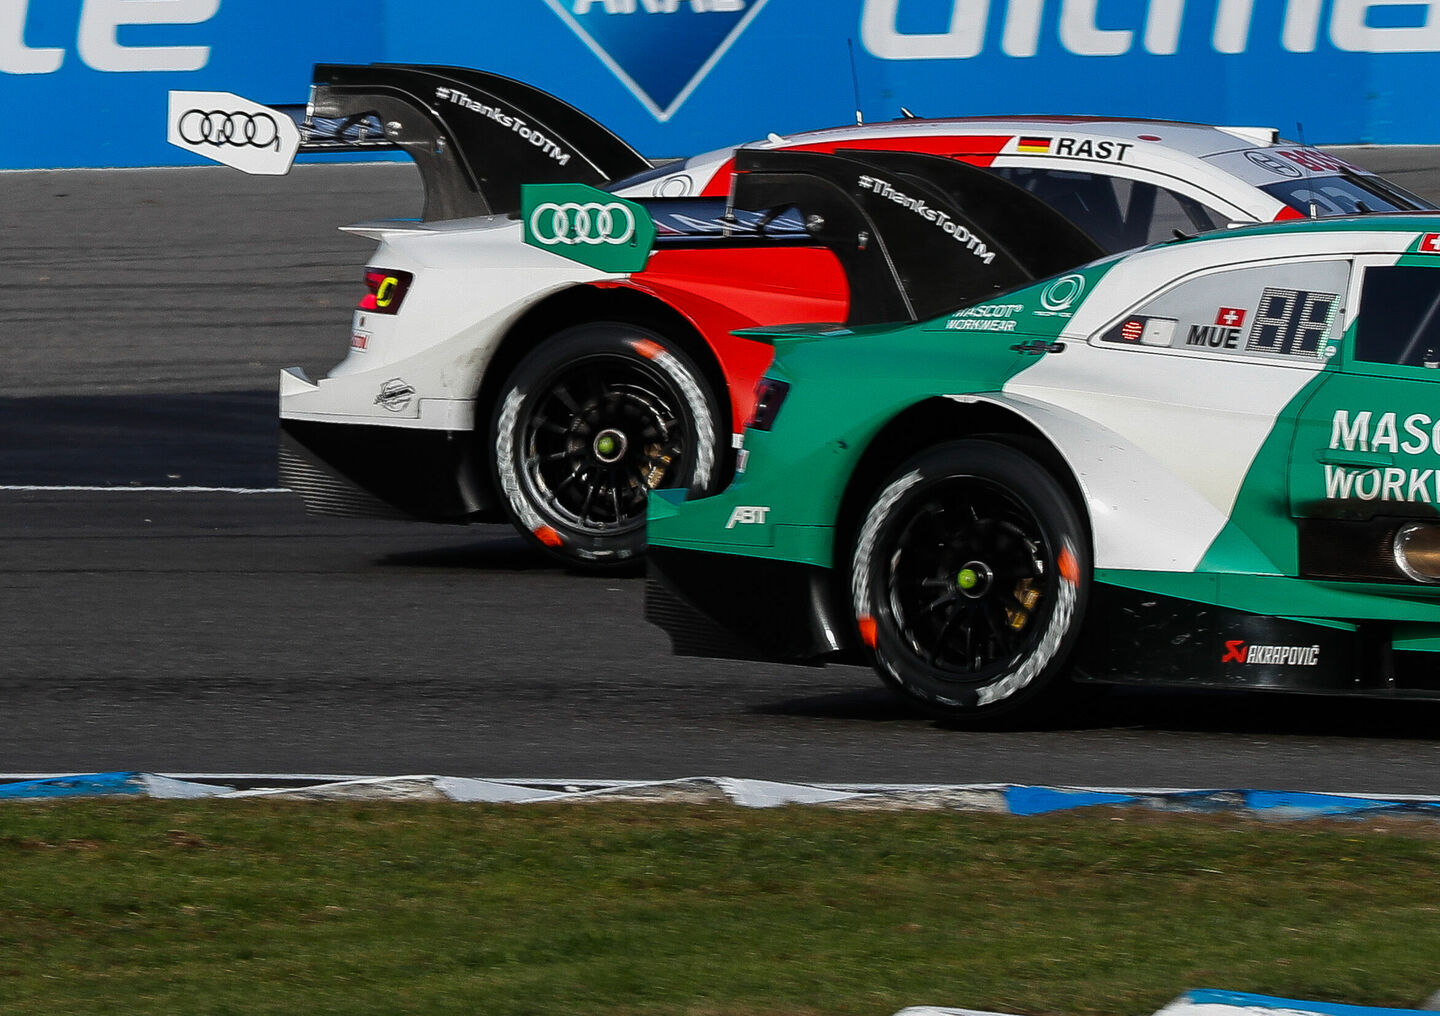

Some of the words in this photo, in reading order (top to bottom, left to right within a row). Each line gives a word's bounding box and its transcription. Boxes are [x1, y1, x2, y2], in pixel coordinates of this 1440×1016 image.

[436, 86, 571, 166] #ThanksToDTM
[1055, 136, 1133, 162] RAST
[857, 174, 996, 265] #ThanksToDTM
[1186, 324, 1242, 350] MUE
[725, 506, 771, 529] ABT
